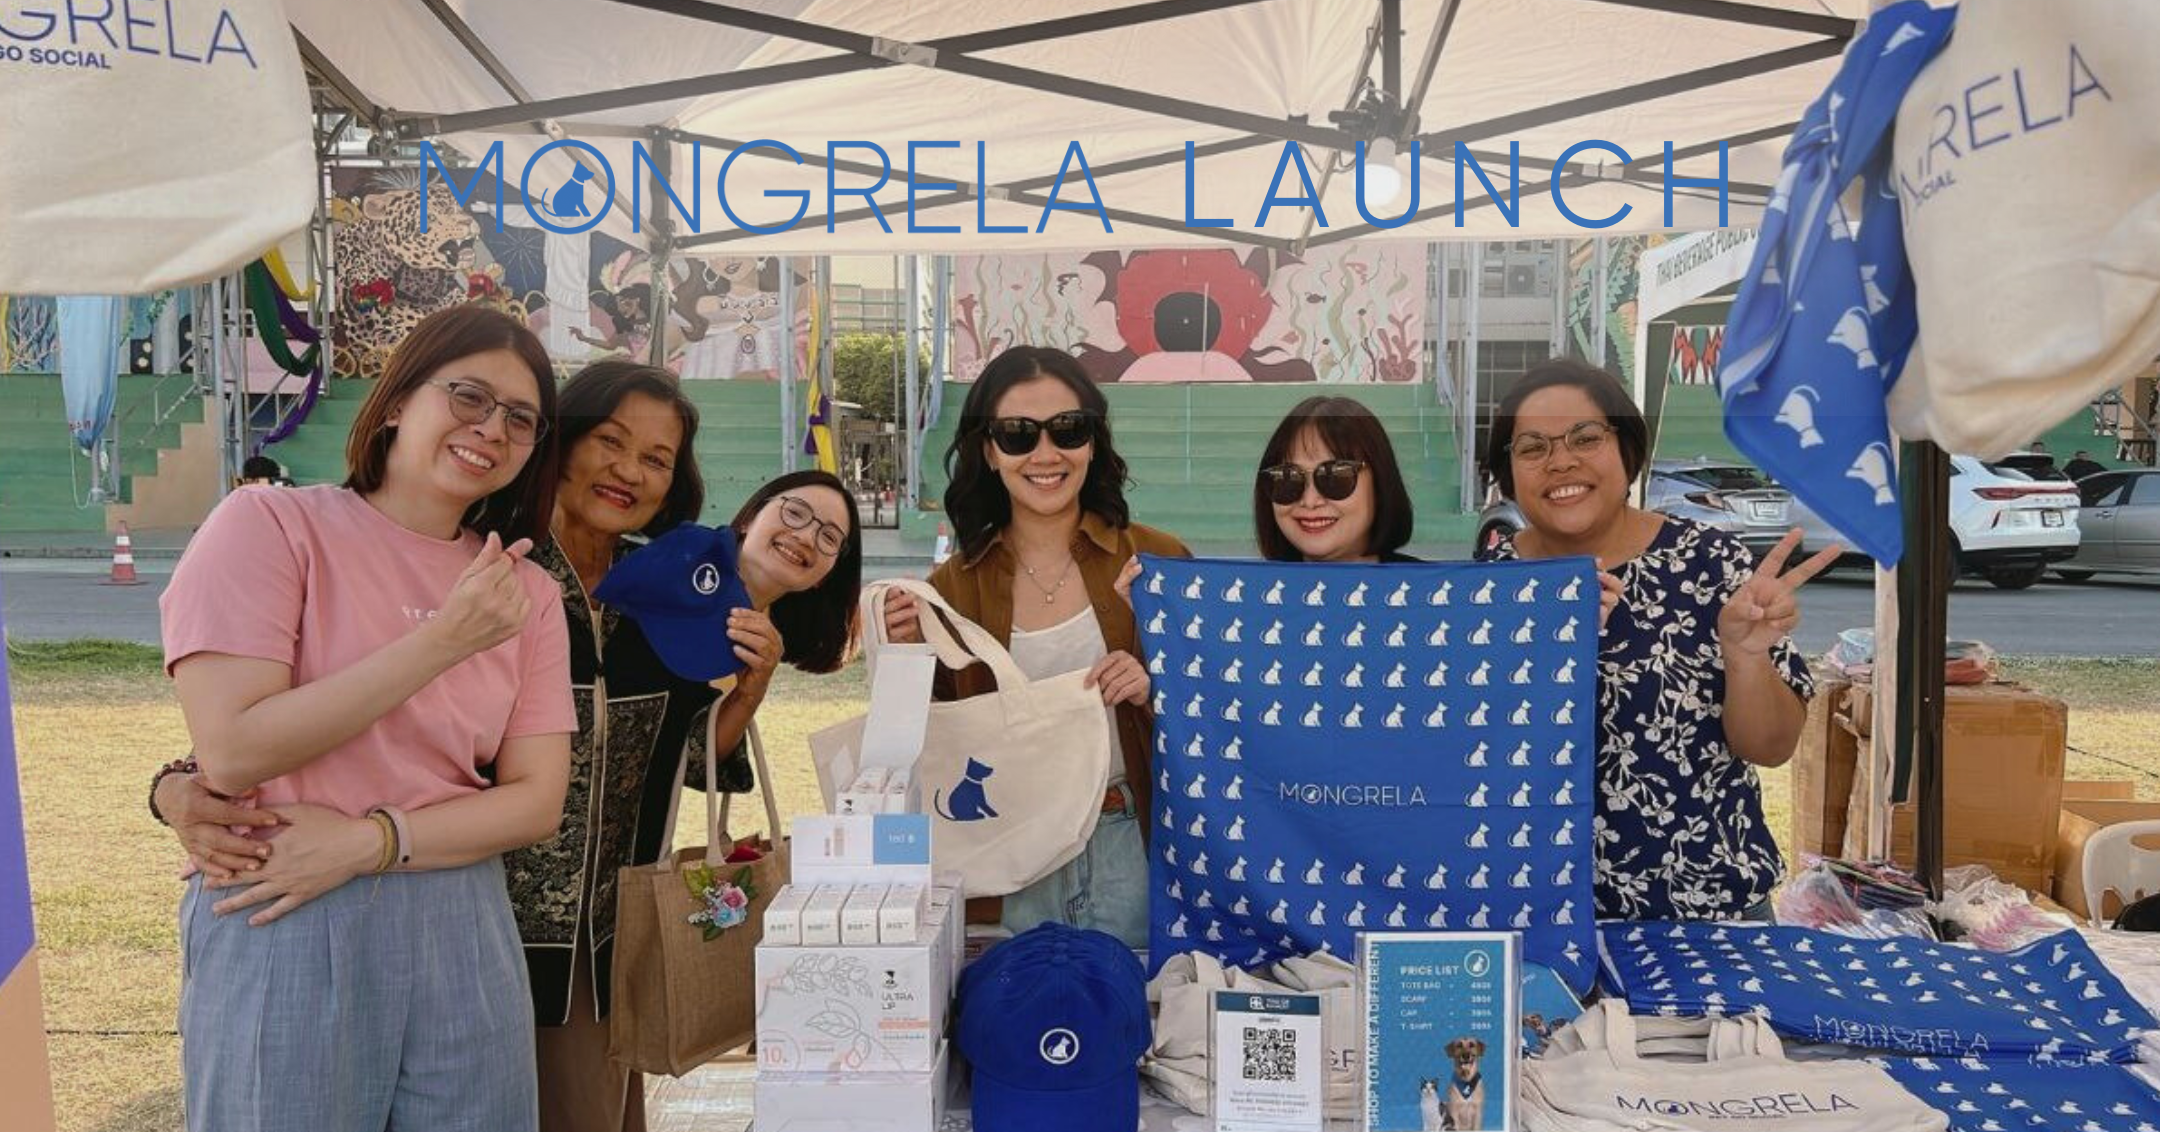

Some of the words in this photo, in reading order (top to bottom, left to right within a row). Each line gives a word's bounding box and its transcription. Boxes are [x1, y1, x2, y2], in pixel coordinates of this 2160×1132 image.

[29, 48, 112, 70] SOCIAL
[1280, 781, 1428, 807] MONGRELA
[1400, 965, 1433, 976] PRICE
[1435, 965, 1460, 976] LIST
[881, 991, 914, 1001] ULTRA
[1401, 981, 1422, 990] TOTE
[1367, 1027, 1380, 1066] MAKE
[1367, 1068, 1380, 1086] TO
[1367, 1090, 1380, 1127] SHOP
[1616, 1093, 1860, 1116] MONGRELA
